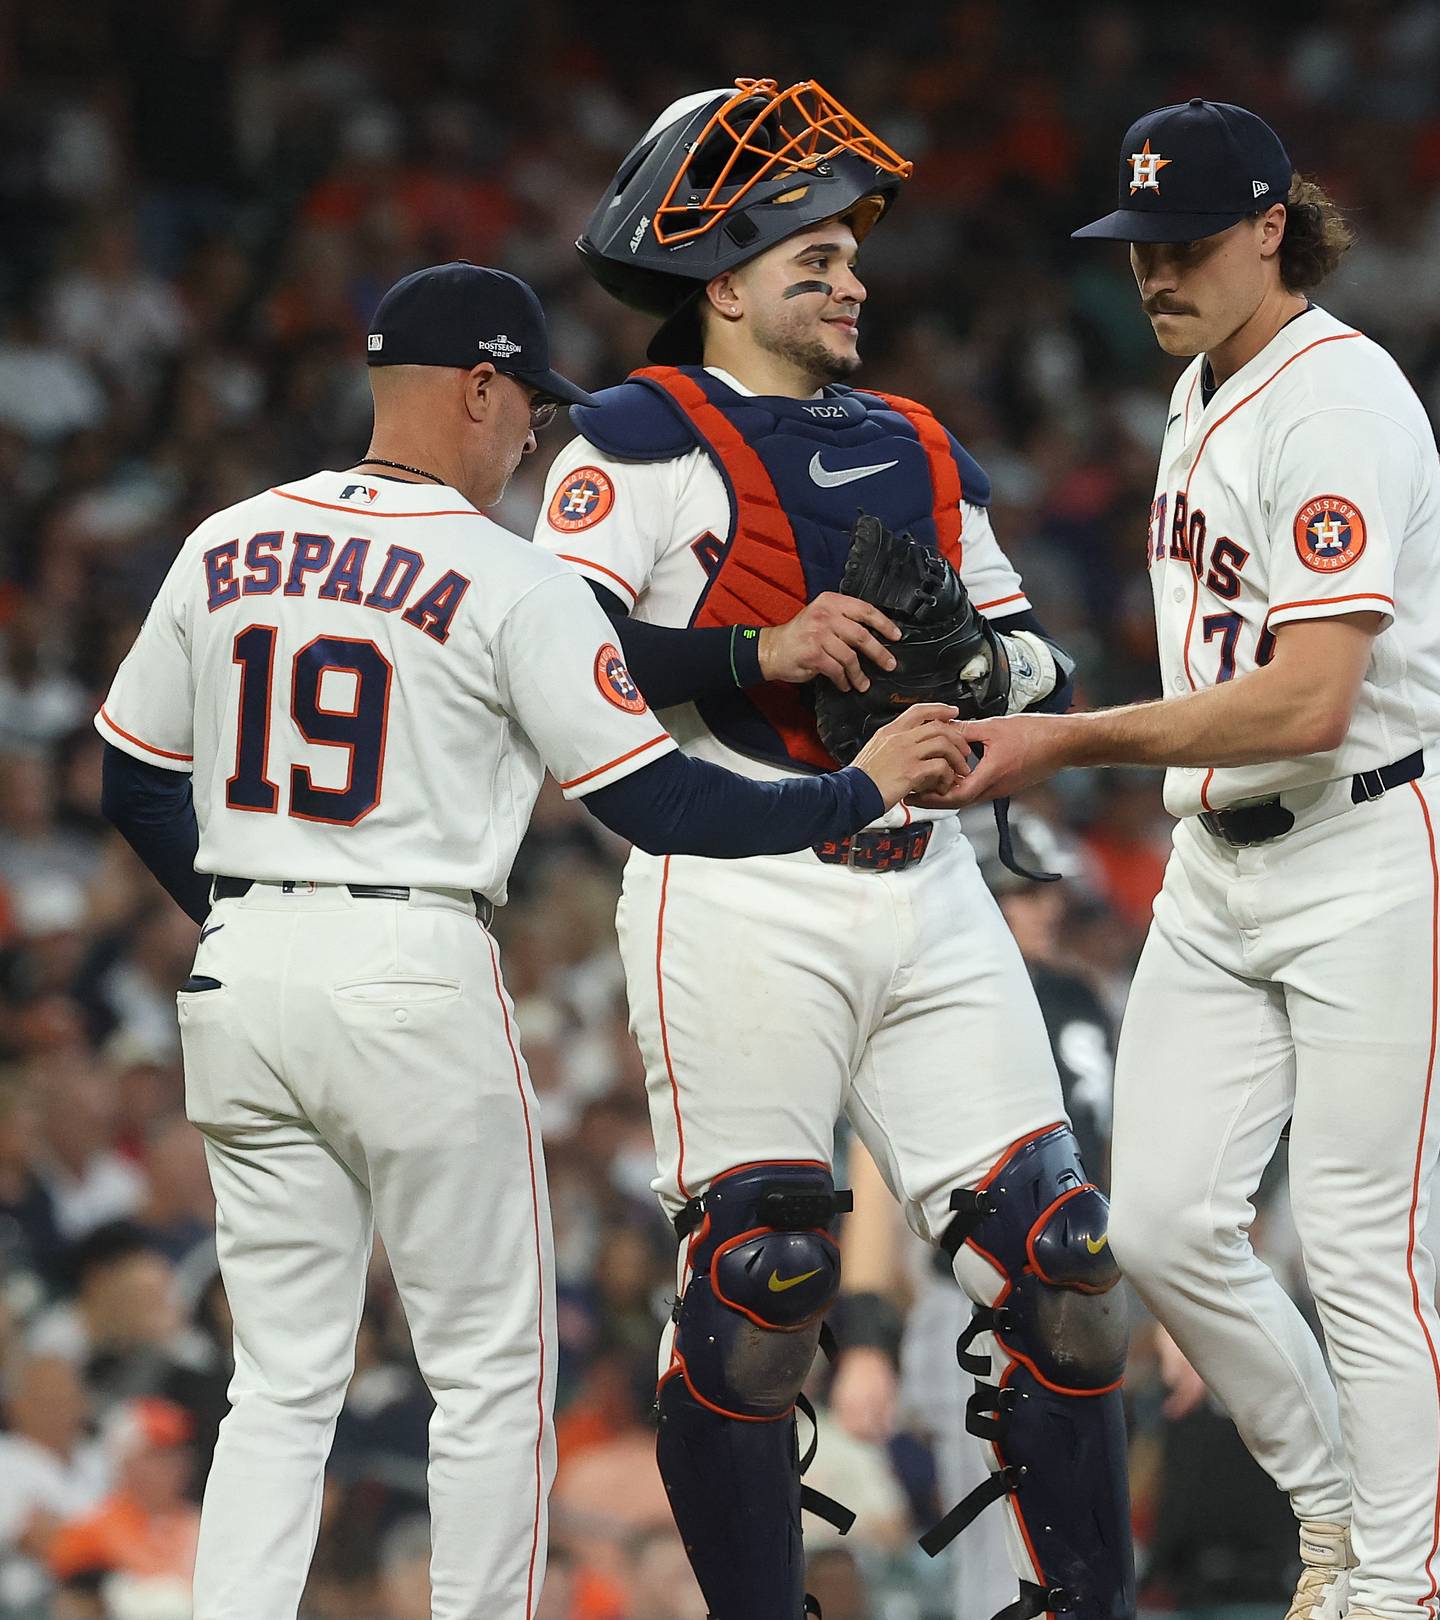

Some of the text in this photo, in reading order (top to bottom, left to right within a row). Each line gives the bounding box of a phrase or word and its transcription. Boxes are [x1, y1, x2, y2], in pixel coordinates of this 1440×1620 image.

[1130, 153, 1161, 189] H
[801, 406, 849, 418] YD21
[1299, 500, 1358, 524] HOUSTON
[1313, 520, 1343, 549] H
[1304, 549, 1356, 568] ASTROS
[203, 530, 472, 646] ESPADA
[225, 624, 394, 827] 19
